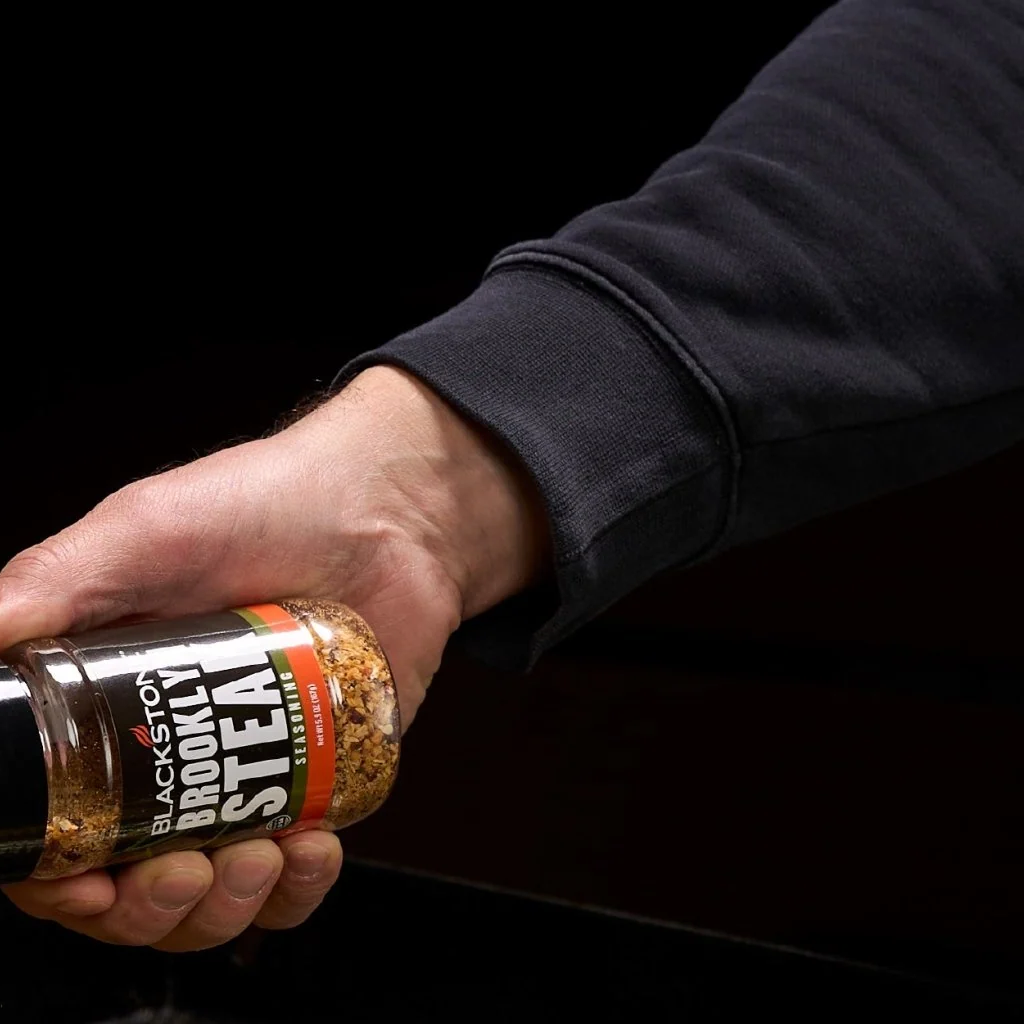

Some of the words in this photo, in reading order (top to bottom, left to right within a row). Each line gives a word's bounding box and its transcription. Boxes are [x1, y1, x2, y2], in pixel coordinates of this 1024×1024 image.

[127, 655, 174, 837] BLACKSTON
[153, 648, 220, 831] BROOKLY
[280, 672, 306, 765] SEASONING
